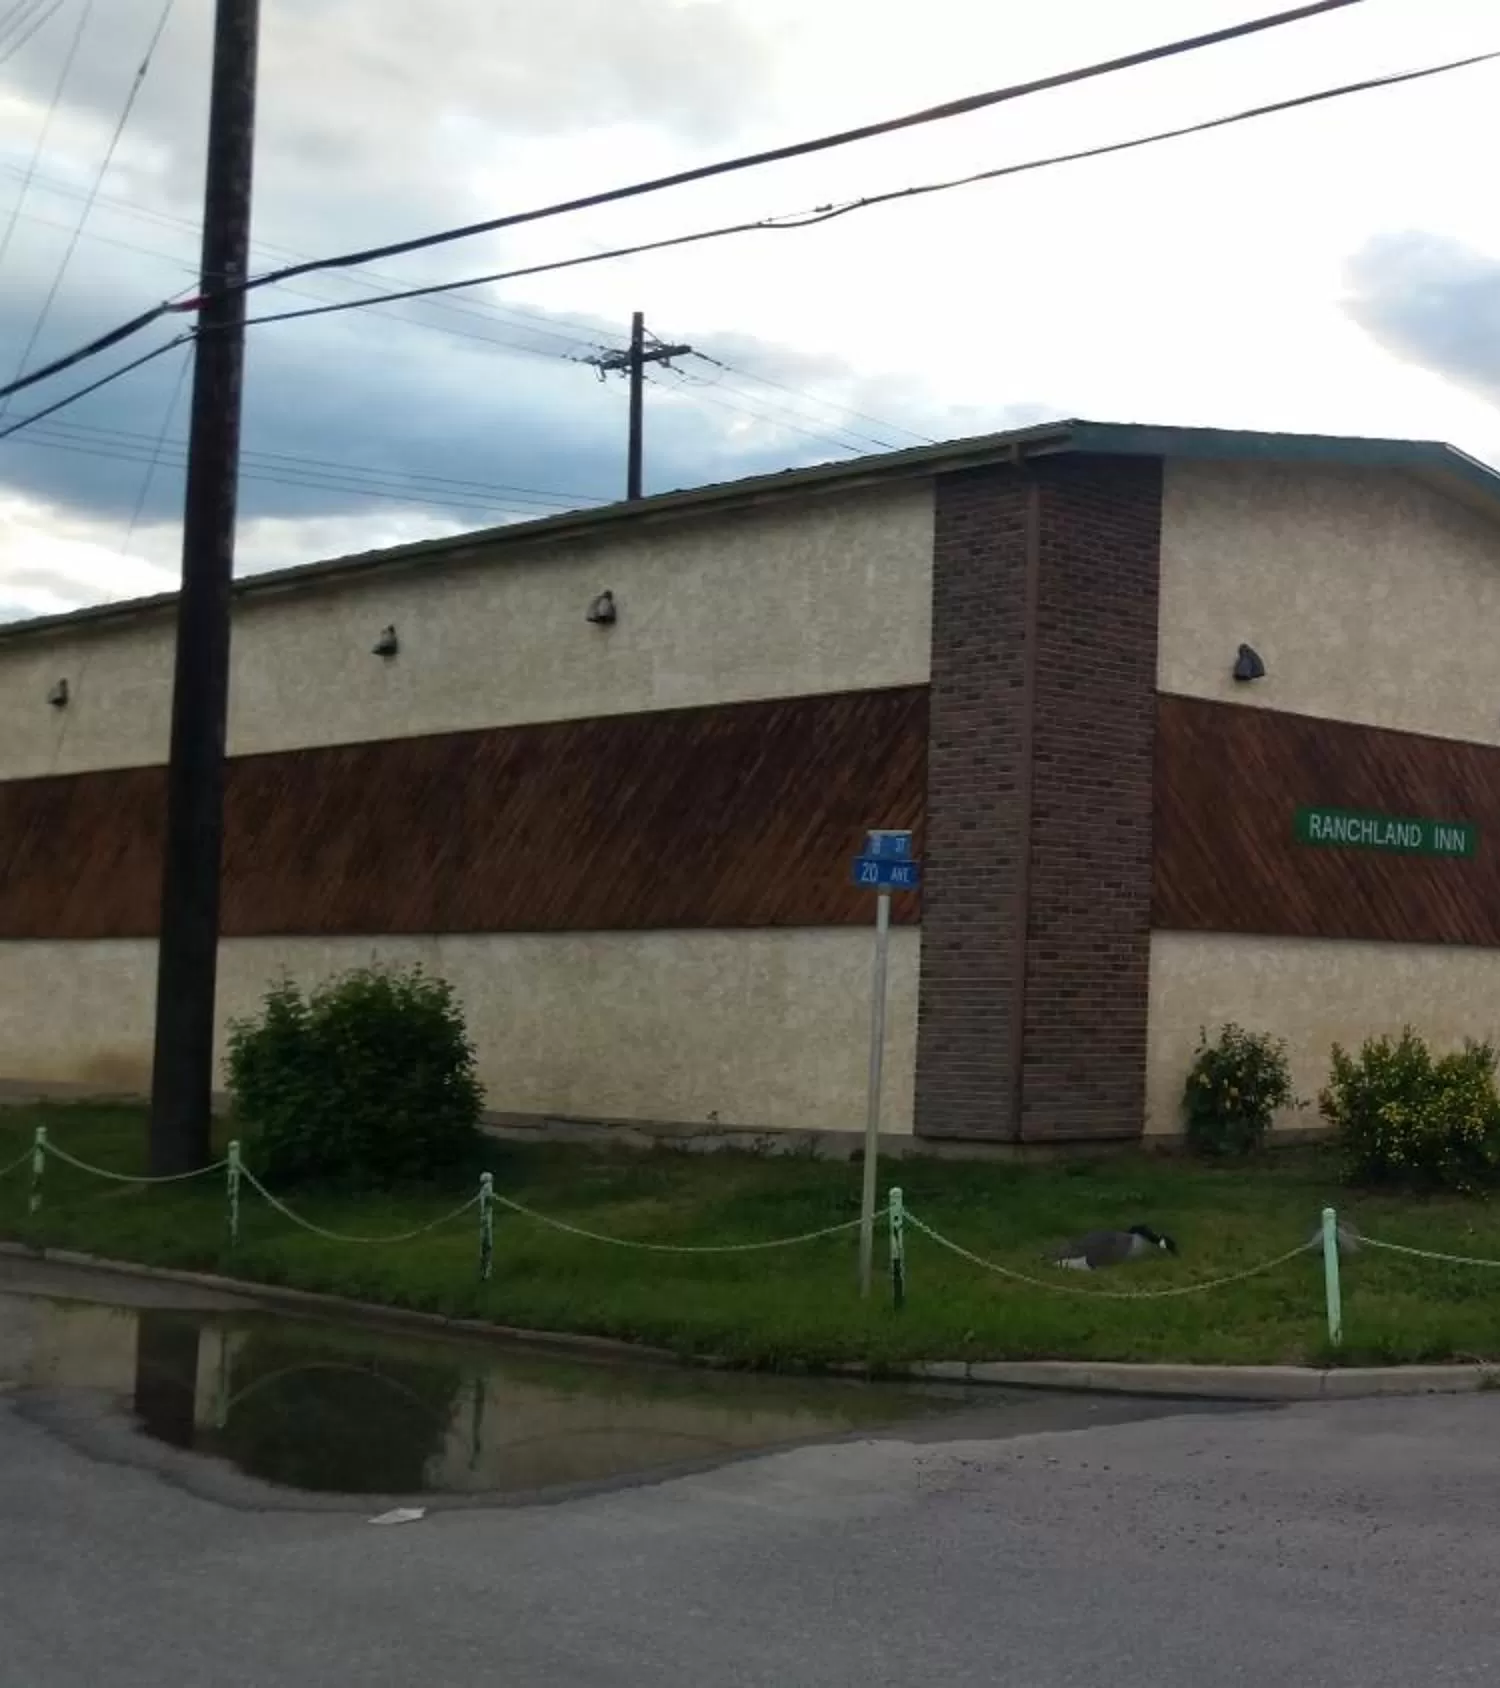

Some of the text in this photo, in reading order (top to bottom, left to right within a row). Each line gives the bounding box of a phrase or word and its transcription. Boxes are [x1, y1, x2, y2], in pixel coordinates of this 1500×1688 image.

[1309, 813, 1466, 852] RANCHLAND INN
[861, 862, 910, 882] 20 AVE
